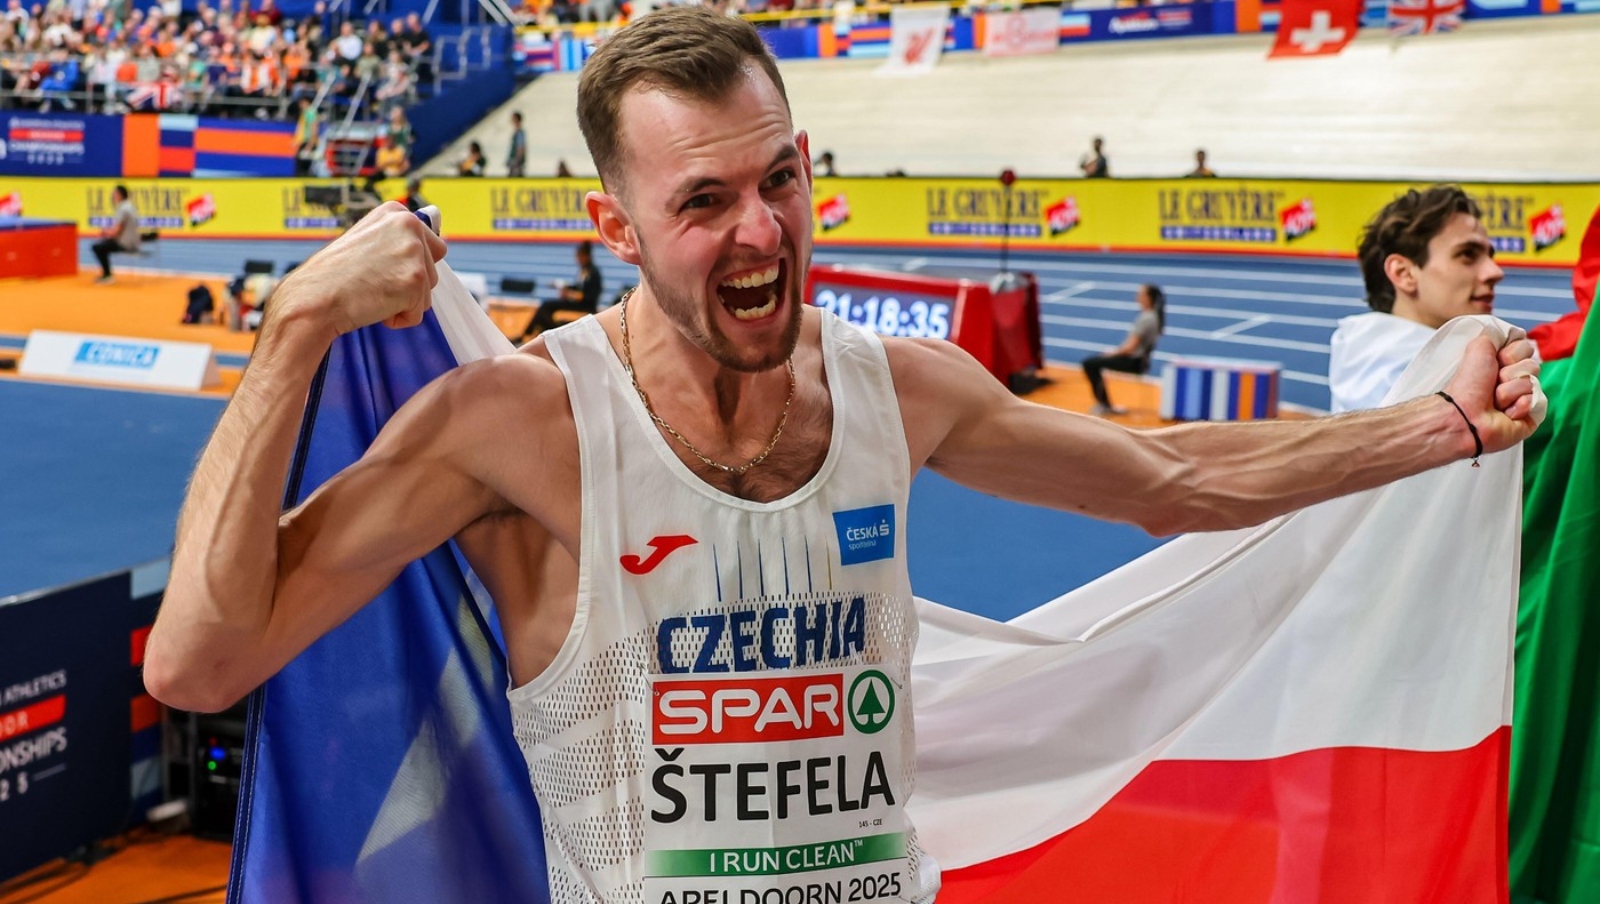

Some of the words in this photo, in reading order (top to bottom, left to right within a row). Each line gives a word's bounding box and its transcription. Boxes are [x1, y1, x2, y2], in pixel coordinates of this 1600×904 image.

[491, 189, 509, 212] LE
[927, 190, 946, 215] LE
[1158, 190, 1180, 220] LE
[846, 522, 879, 541] ČESKÁ
[657, 594, 866, 675] CZECHIA
[4, 669, 66, 705] ATHLETICS
[659, 684, 840, 734] SPAR
[651, 748, 895, 823] ŠTEFELA
[710, 853, 716, 872] I
[723, 851, 780, 872] RUN
[848, 872, 901, 901] 2025
